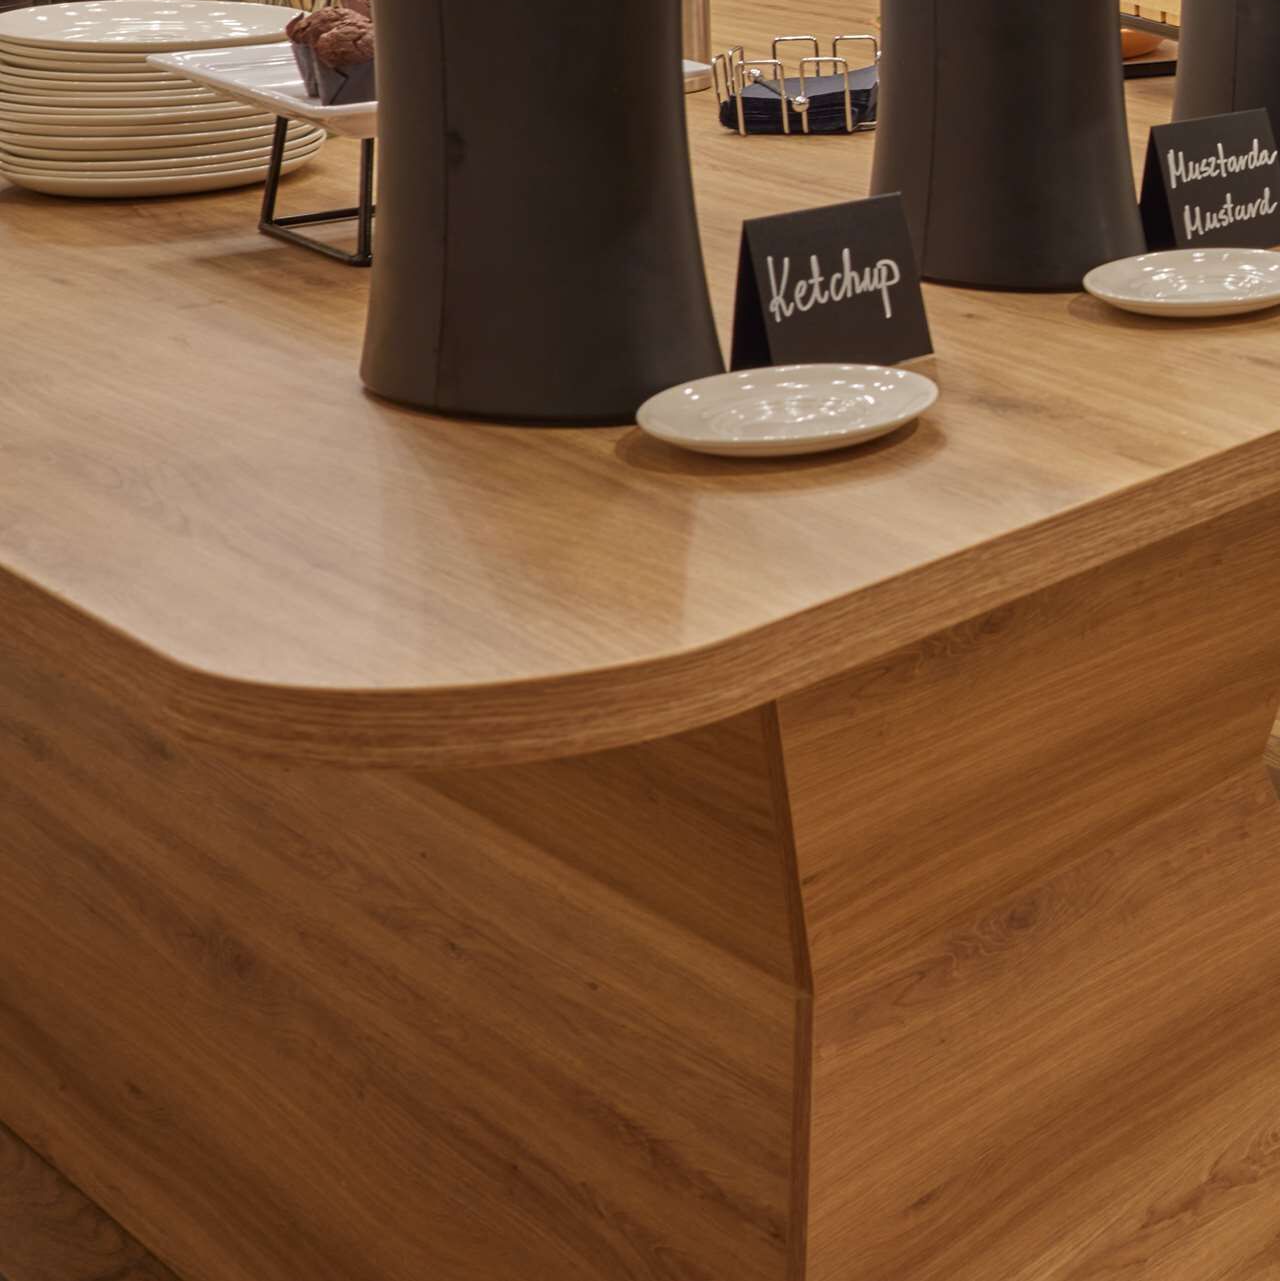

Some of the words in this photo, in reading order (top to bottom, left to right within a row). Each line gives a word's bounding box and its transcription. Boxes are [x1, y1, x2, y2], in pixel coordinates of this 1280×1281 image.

[1167, 138, 1278, 189] Musztarda
[1184, 187, 1278, 240] Mustard
[767, 247, 900, 322] Ketchup
